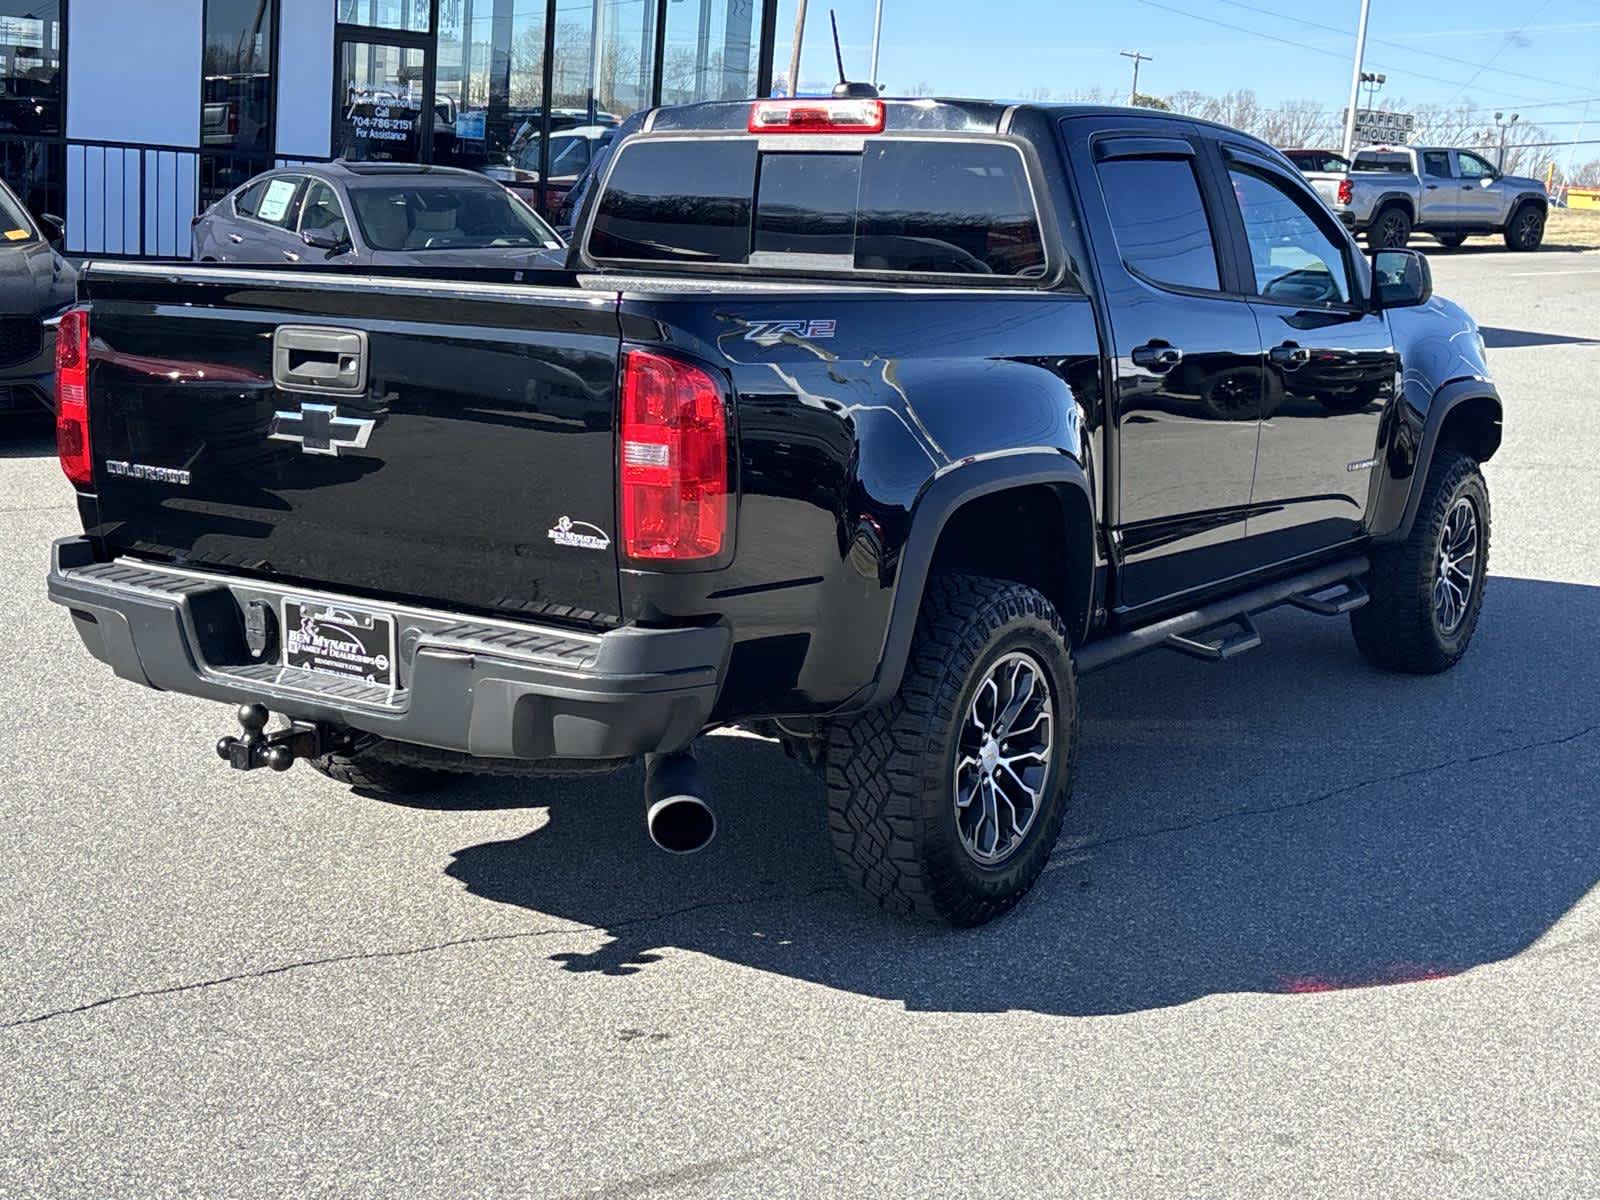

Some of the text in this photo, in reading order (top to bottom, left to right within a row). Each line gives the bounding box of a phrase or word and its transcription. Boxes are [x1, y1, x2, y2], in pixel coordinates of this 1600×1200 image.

[375, 107, 390, 118] Call
[352, 116, 413, 130] 704-786-2151
[1359, 114, 1412, 129] WAFFLE
[356, 128, 407, 141] For Assistance
[1361, 129, 1404, 142] HOUSE
[743, 319, 836, 340] ZR2
[105, 459, 191, 485] COLORADO
[288, 630, 359, 655] BEN MYNATT
[329, 648, 375, 666] DEALERSHIPS
